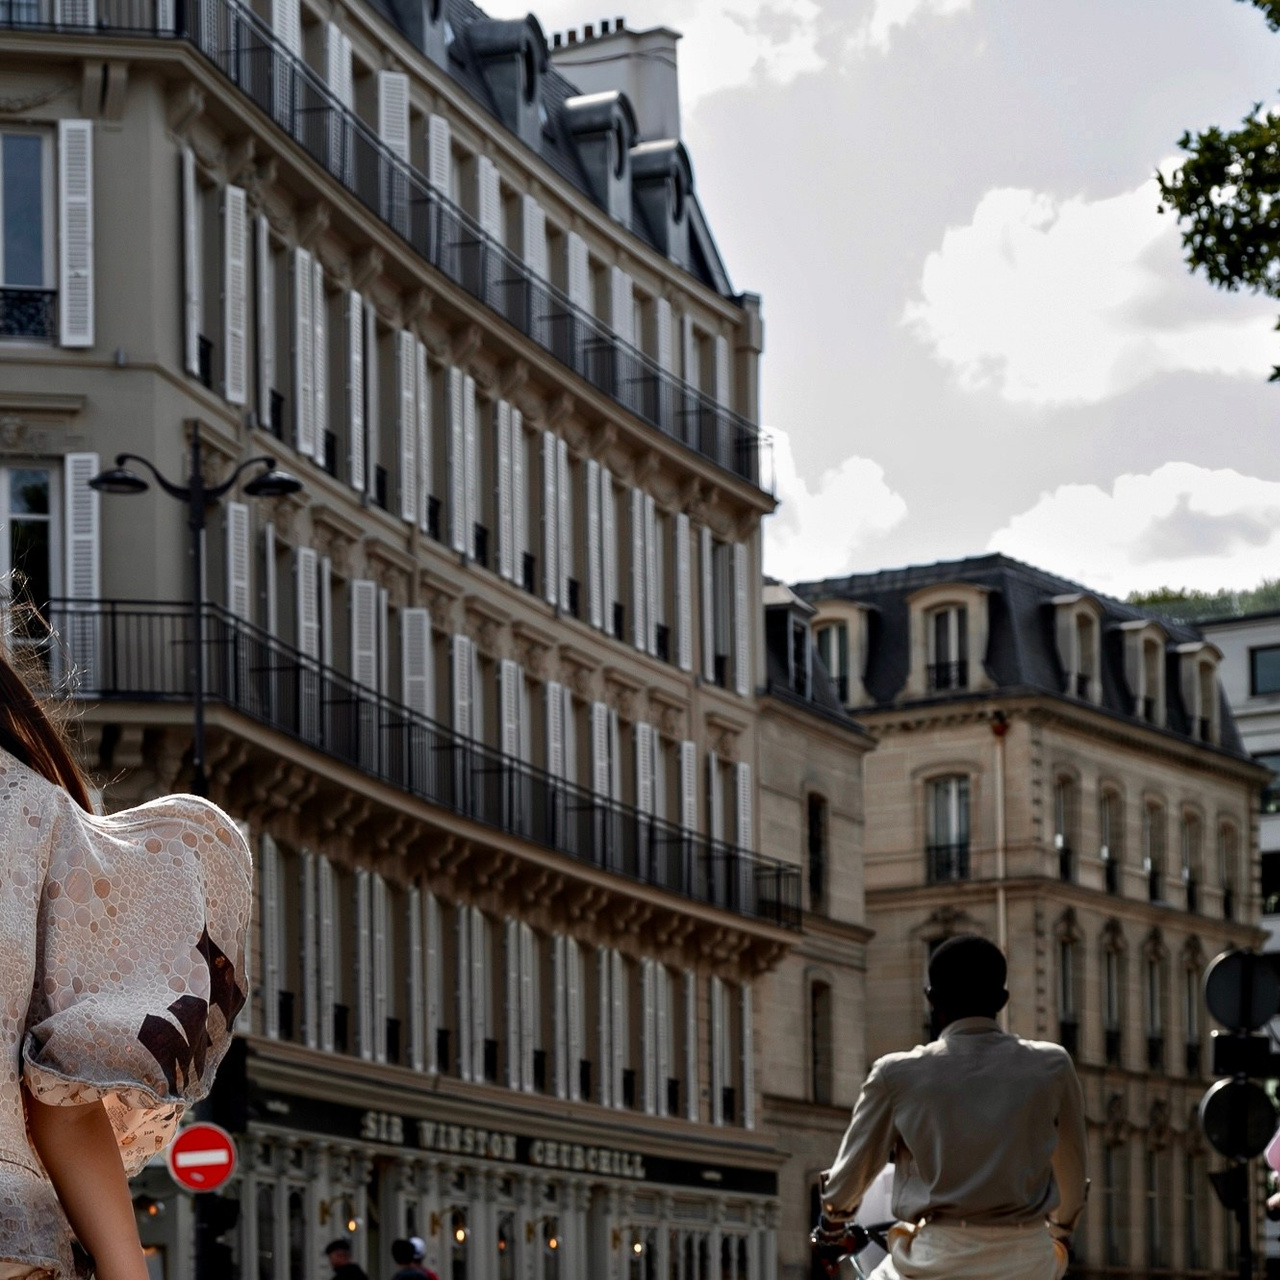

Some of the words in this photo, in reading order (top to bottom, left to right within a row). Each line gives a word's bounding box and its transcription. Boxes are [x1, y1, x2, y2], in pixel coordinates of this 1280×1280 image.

[361, 1111, 404, 1144] SIR
[418, 1120, 517, 1161] WINSTON
[528, 1139, 646, 1179] CHURCHILL
